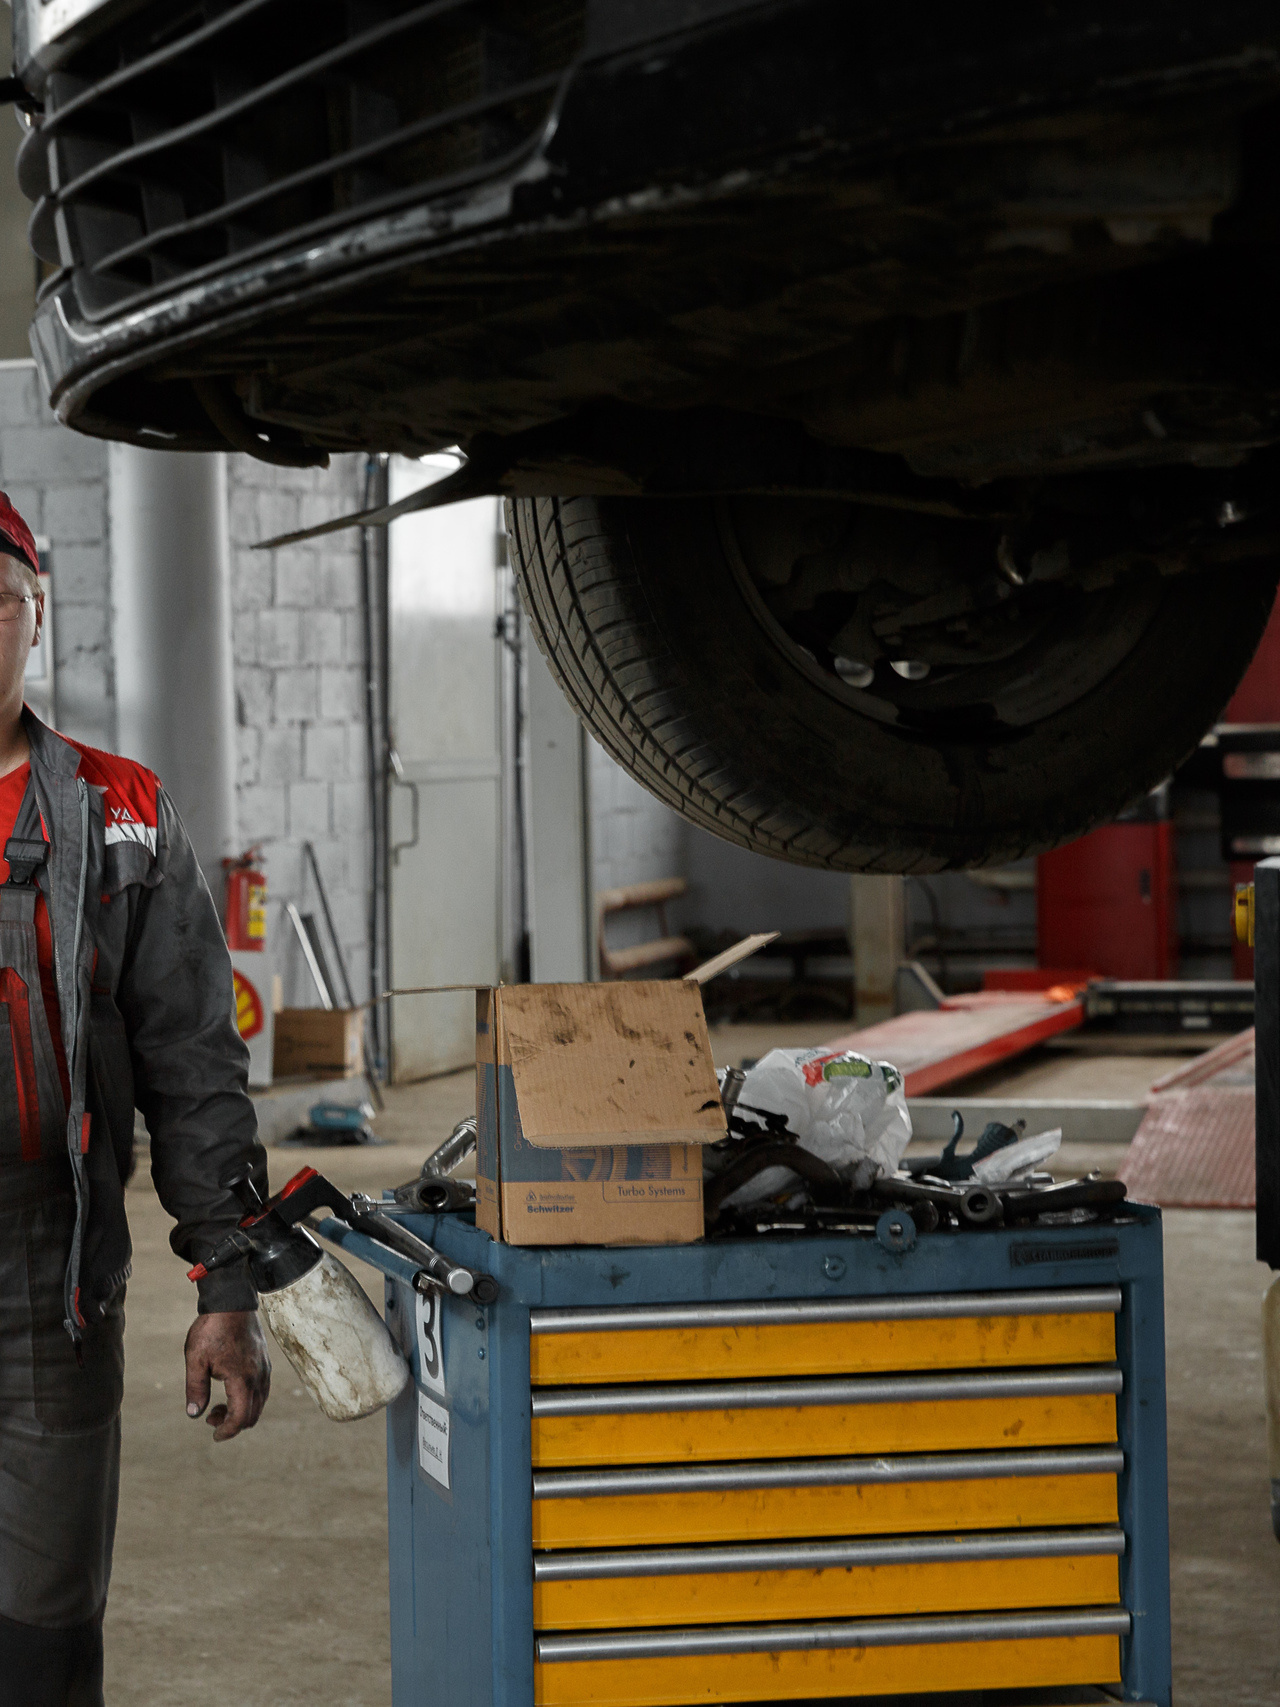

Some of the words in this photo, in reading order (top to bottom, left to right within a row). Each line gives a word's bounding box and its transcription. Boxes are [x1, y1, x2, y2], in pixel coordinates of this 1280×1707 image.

[617, 1185, 646, 1196] Turbo
[648, 1184, 686, 1198] Systems
[527, 1205, 574, 1213] Schwitzer
[422, 1294, 440, 1380] 3
